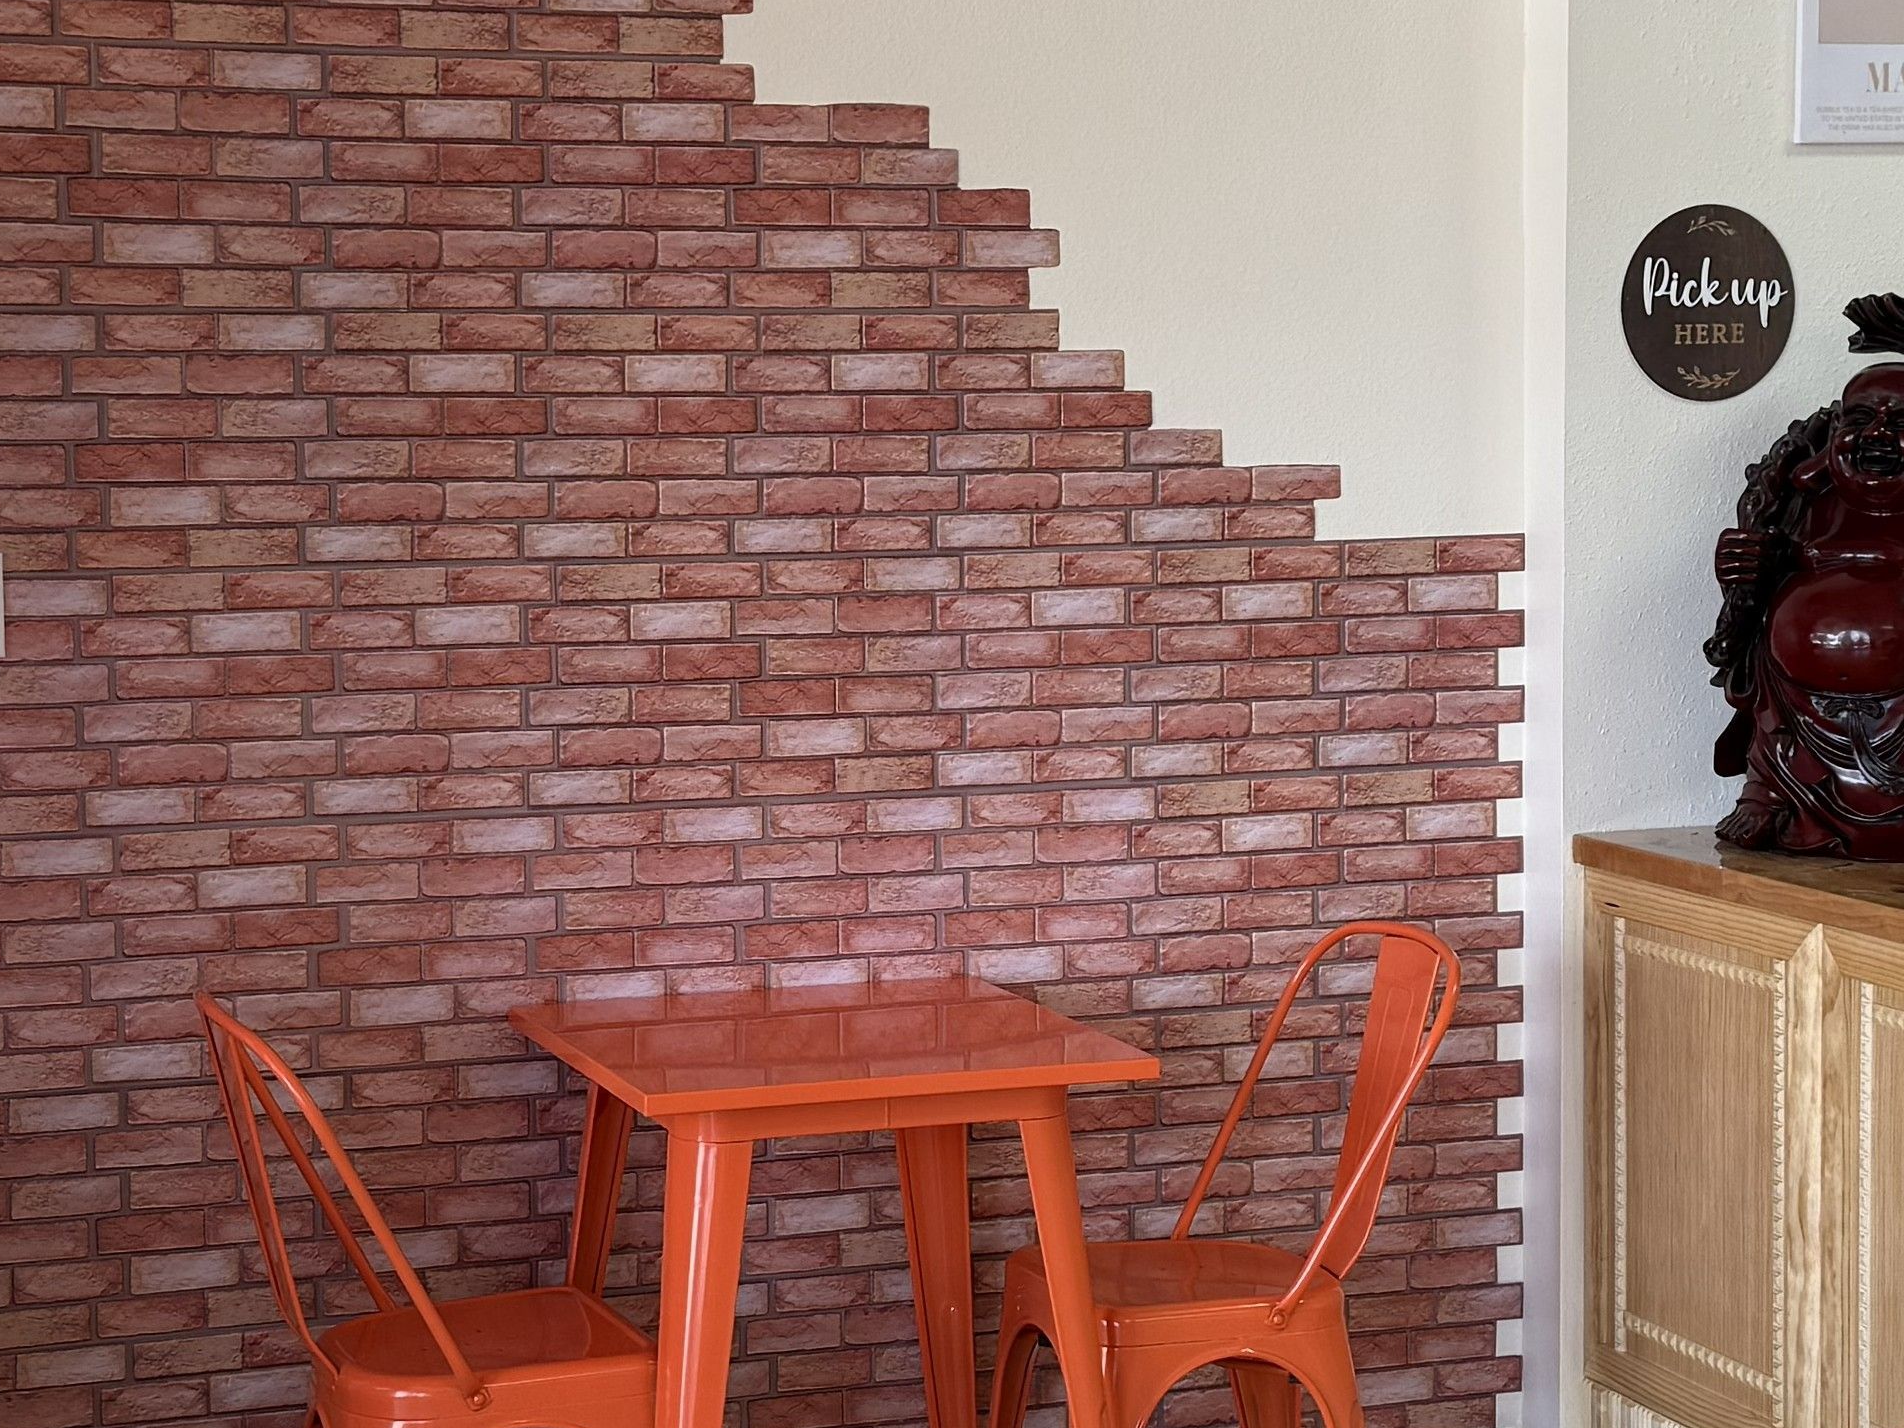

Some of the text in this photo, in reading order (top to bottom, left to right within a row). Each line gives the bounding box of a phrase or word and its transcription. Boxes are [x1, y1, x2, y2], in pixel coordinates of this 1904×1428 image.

[1642, 256, 1789, 329] Pick up
[1674, 323, 1745, 345] HERE
